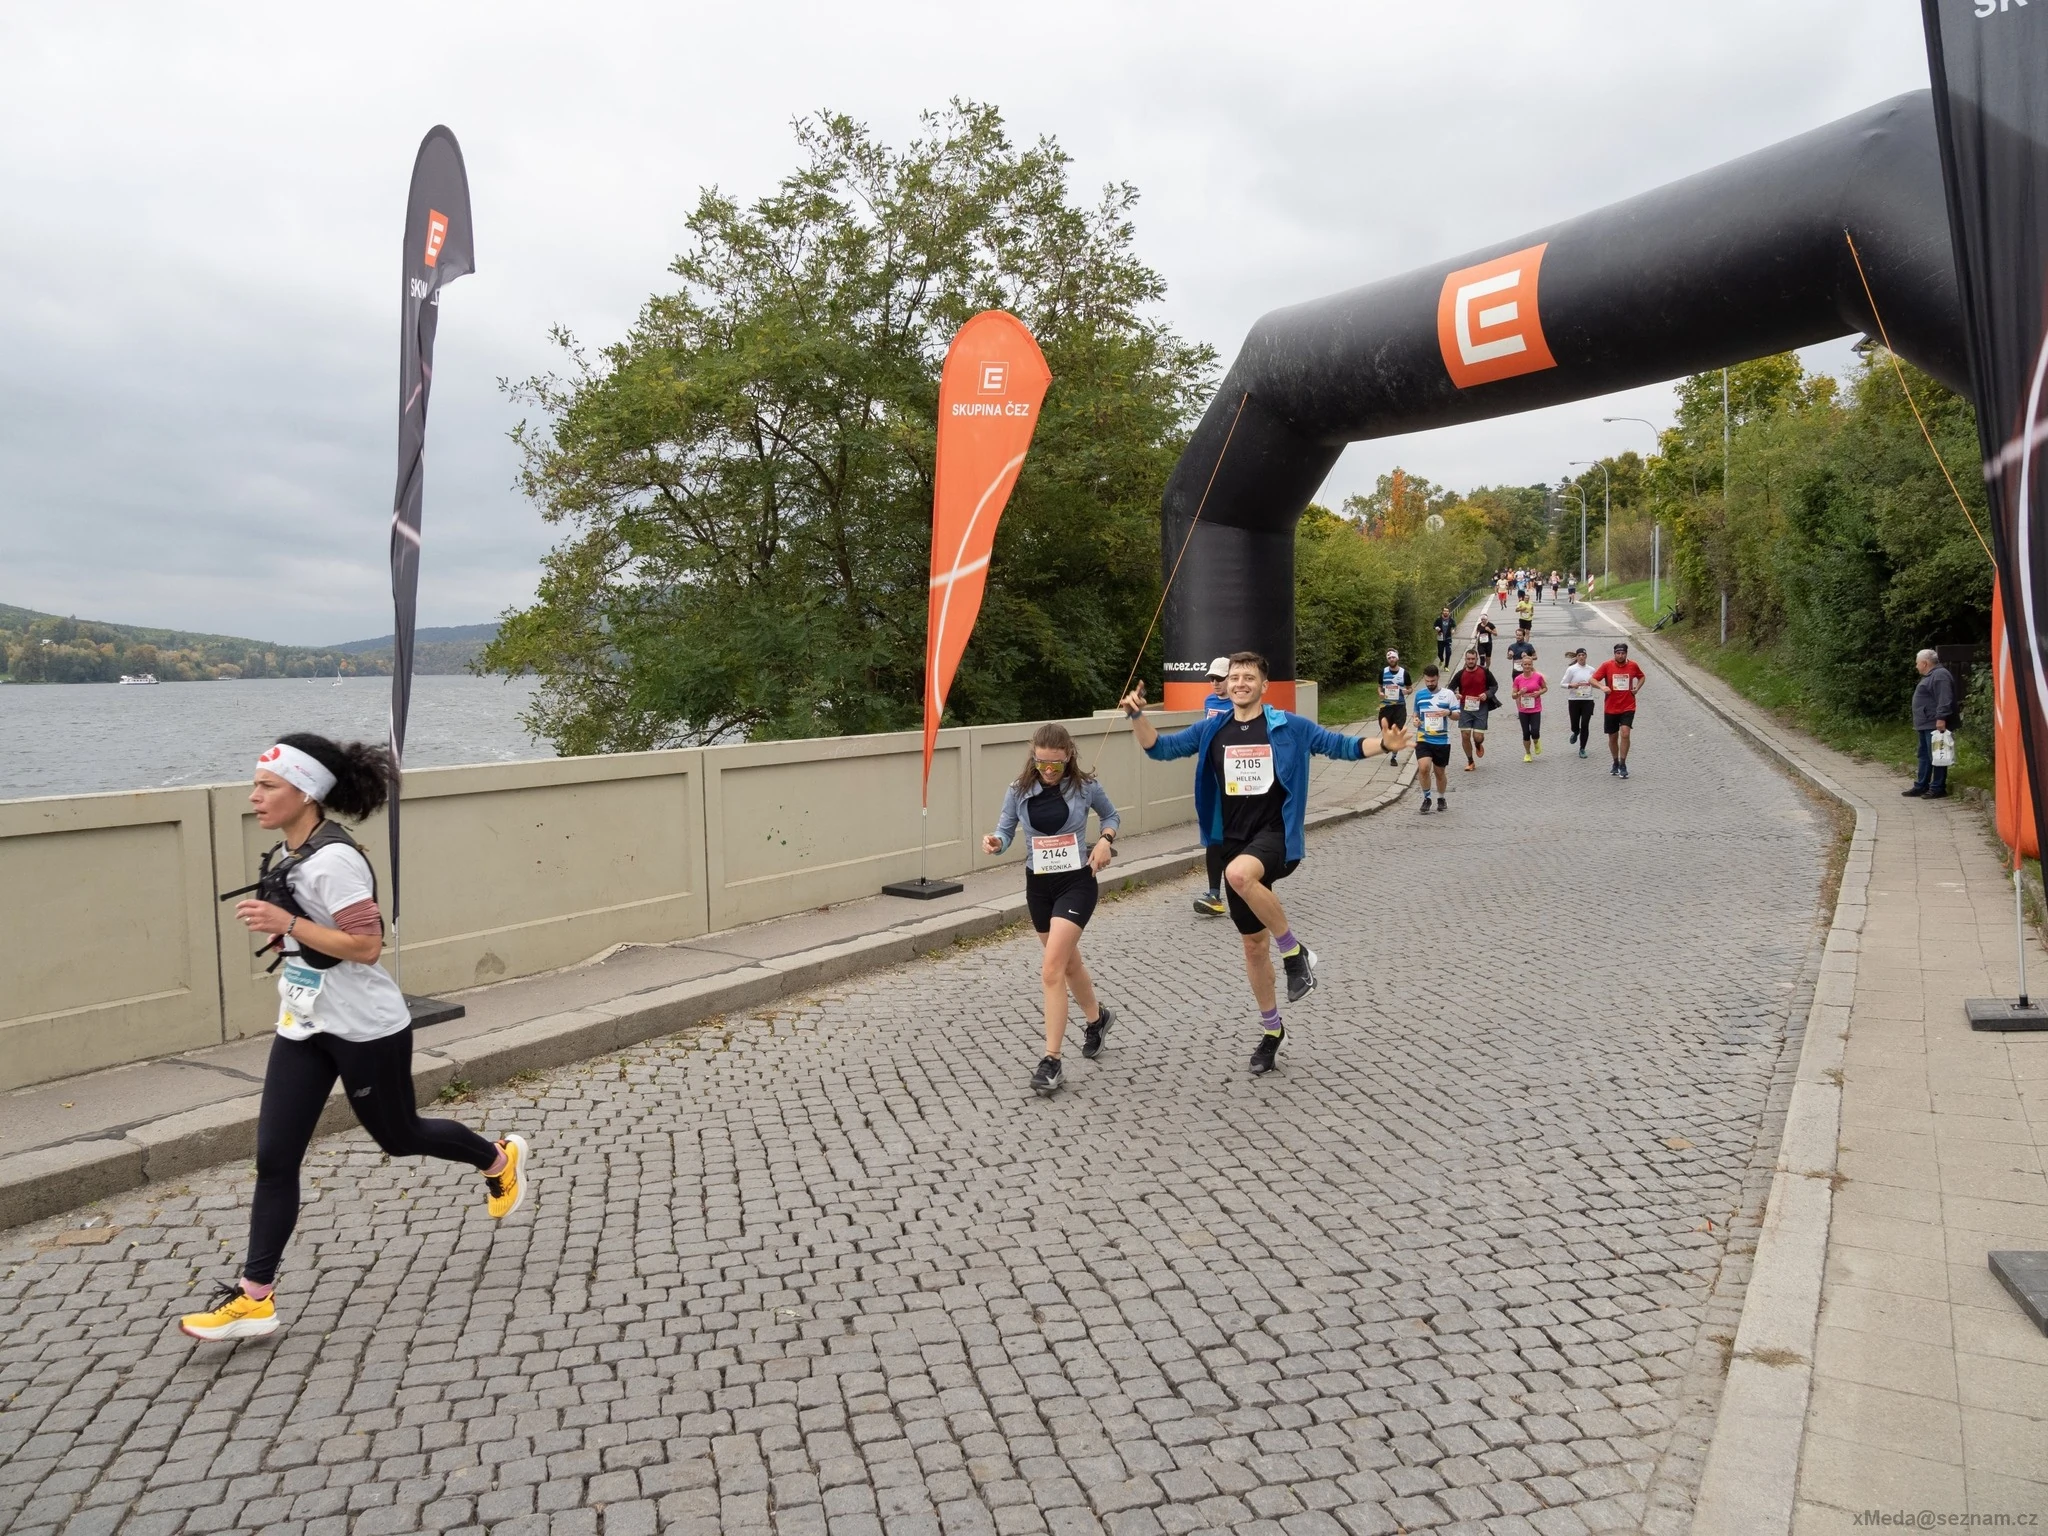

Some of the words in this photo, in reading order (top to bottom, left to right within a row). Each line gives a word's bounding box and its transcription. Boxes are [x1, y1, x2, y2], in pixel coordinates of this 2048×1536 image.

[952, 403, 1002, 416] SKUPINA
[1005, 401, 1030, 416] ČEZ
[1235, 759, 1261, 769] 2105
[1042, 848, 1068, 860] 2146
[1041, 863, 1072, 872] VERONIKA
